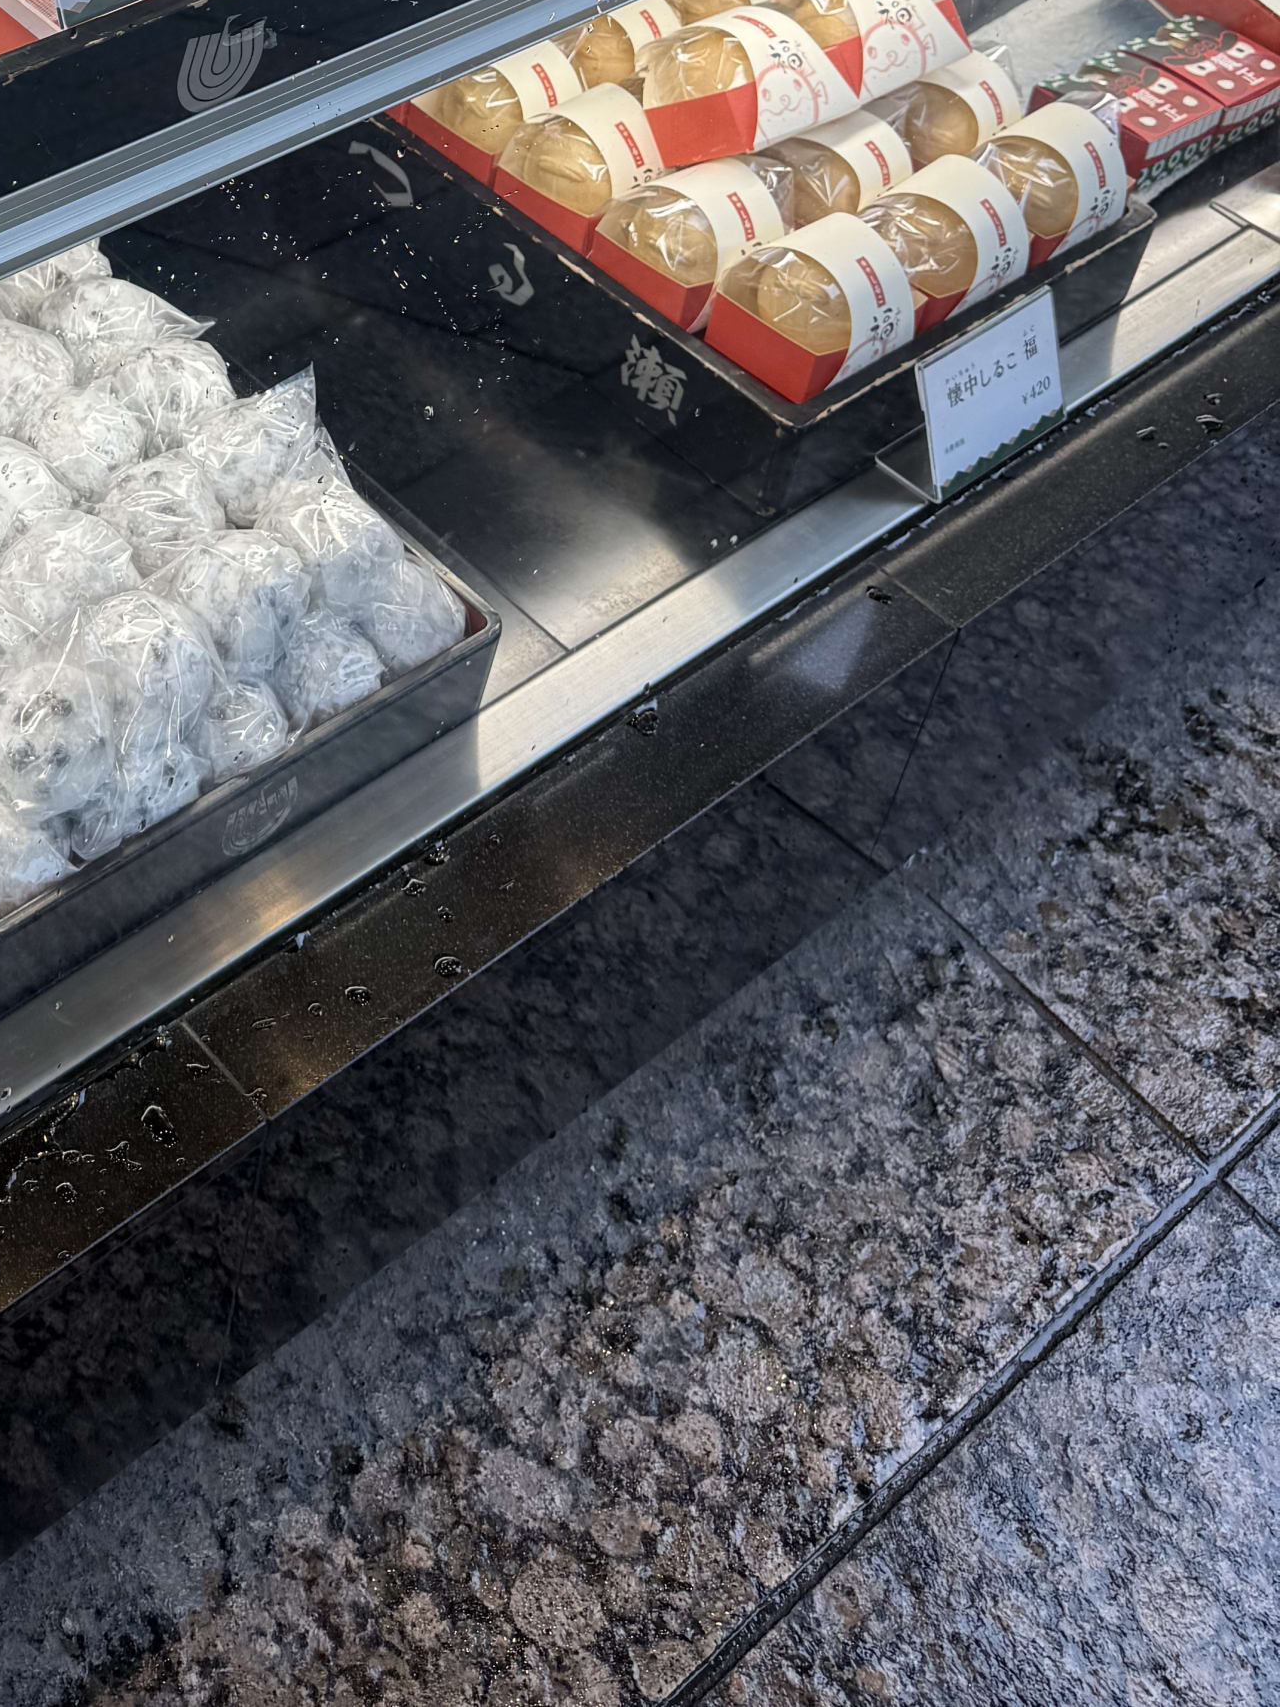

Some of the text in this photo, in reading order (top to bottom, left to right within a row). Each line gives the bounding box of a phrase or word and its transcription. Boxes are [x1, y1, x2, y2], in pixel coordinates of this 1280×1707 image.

[947, 335, 1039, 408] 懐中しるこ 福
[1021, 376, 1051, 404] ¥420
